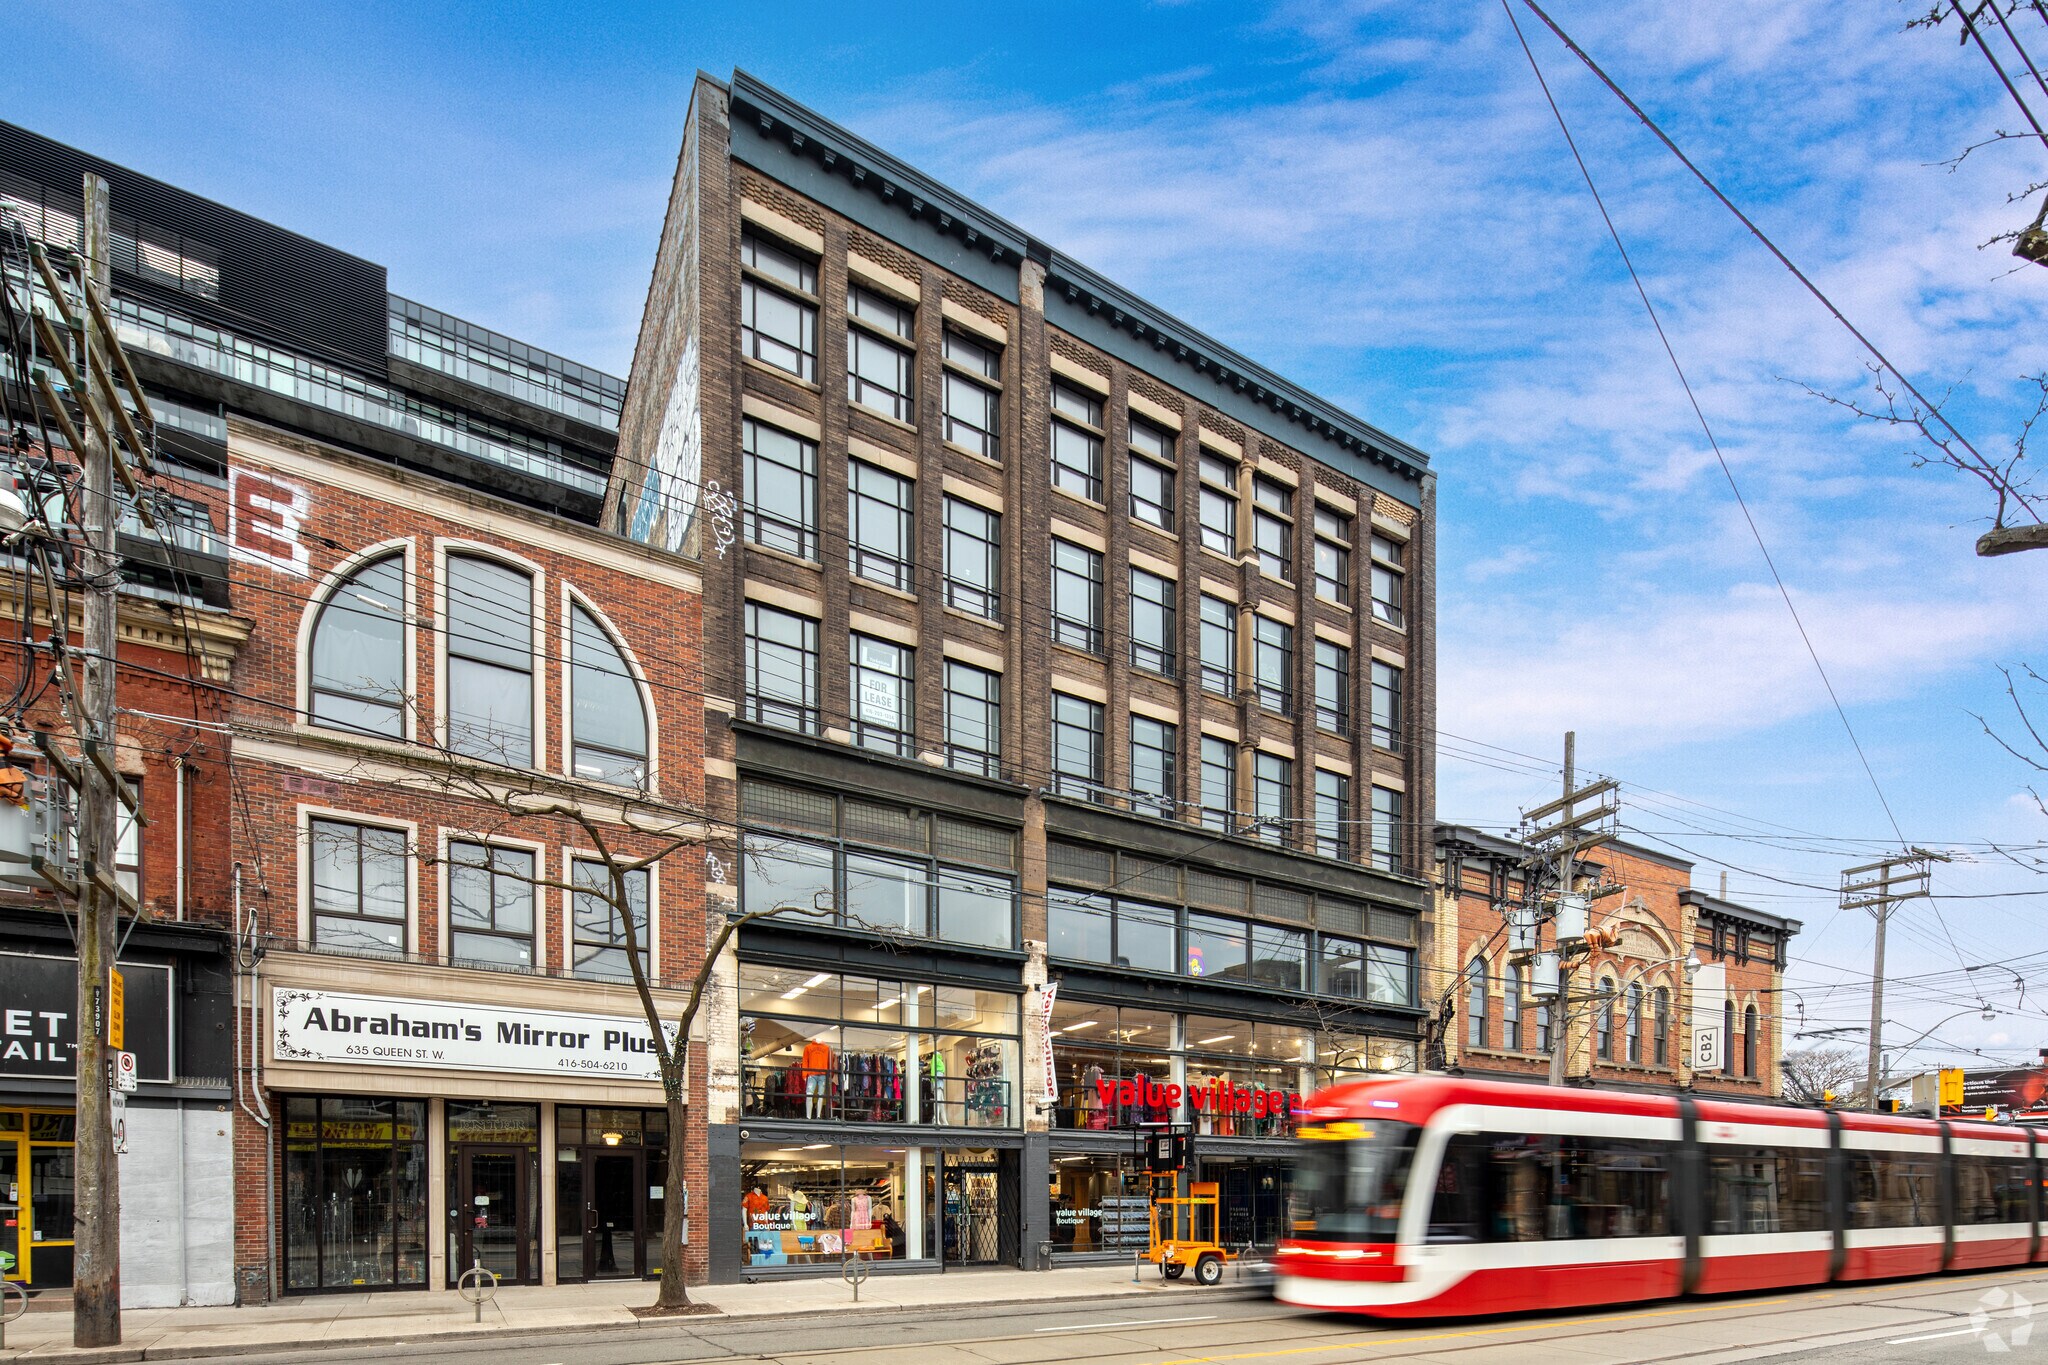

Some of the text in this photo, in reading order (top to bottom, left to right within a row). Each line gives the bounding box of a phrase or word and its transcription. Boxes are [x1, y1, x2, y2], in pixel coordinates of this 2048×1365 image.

[869, 679, 887, 694] FOR
[864, 690, 892, 708] LEASE
[5, 1009, 68, 1038] ET
[303, 1007, 659, 1054] Abraham's Mirror Plus
[346, 1045, 445, 1060] 635 QUEEN ST. W.
[1701, 1033, 1712, 1062] CB2
[558, 1058, 628, 1071] 416-504-6210
[1044, 1039, 1055, 1097] village
[1096, 1073, 1182, 1108] value
[1189, 1078, 1283, 1119] village
[457, 1119, 526, 1131] ENTER
[804, 1133, 881, 1143] CARPETS
[890, 1135, 920, 1145] AND
[752, 1210, 817, 1222] value village
[1055, 1208, 1102, 1218] value village
